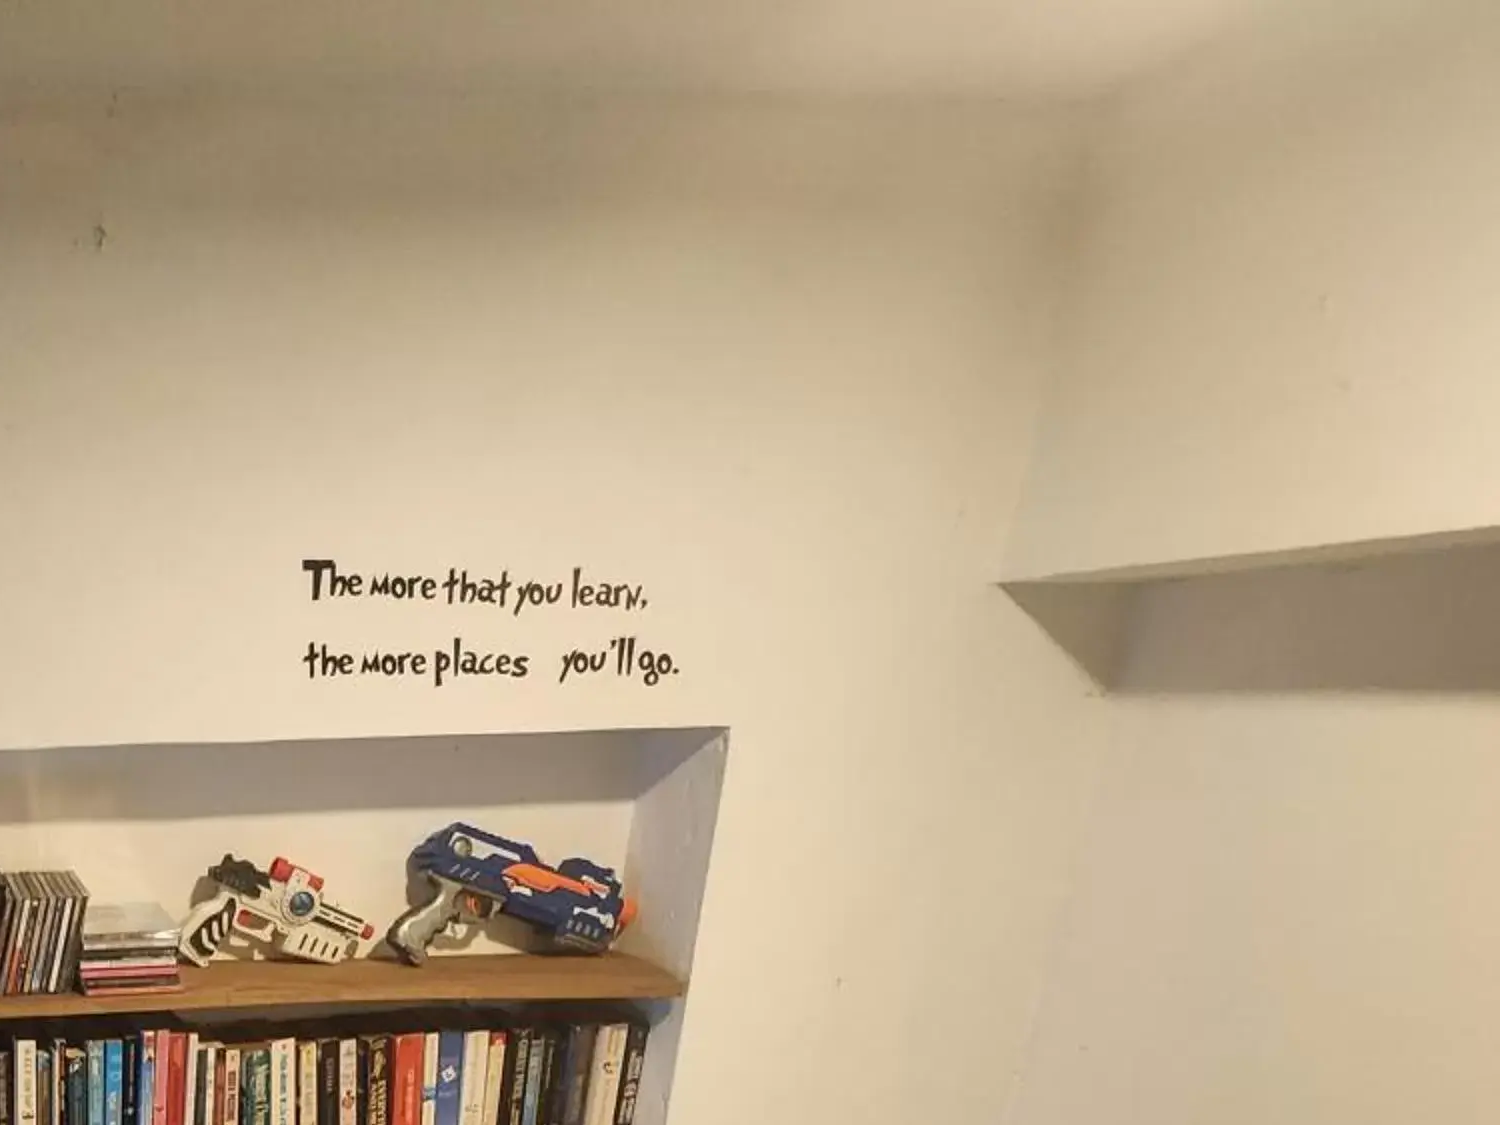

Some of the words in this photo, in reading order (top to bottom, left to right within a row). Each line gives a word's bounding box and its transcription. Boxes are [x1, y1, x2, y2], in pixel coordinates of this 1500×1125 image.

[302, 559, 363, 601] The
[370, 571, 437, 600] more
[441, 567, 512, 608] that
[512, 576, 563, 617] you
[571, 567, 649, 611] learn,
[302, 641, 355, 679] the
[360, 647, 427, 676] more
[433, 637, 530, 688] places
[559, 636, 637, 684] you'll
[638, 649, 681, 687] go.
